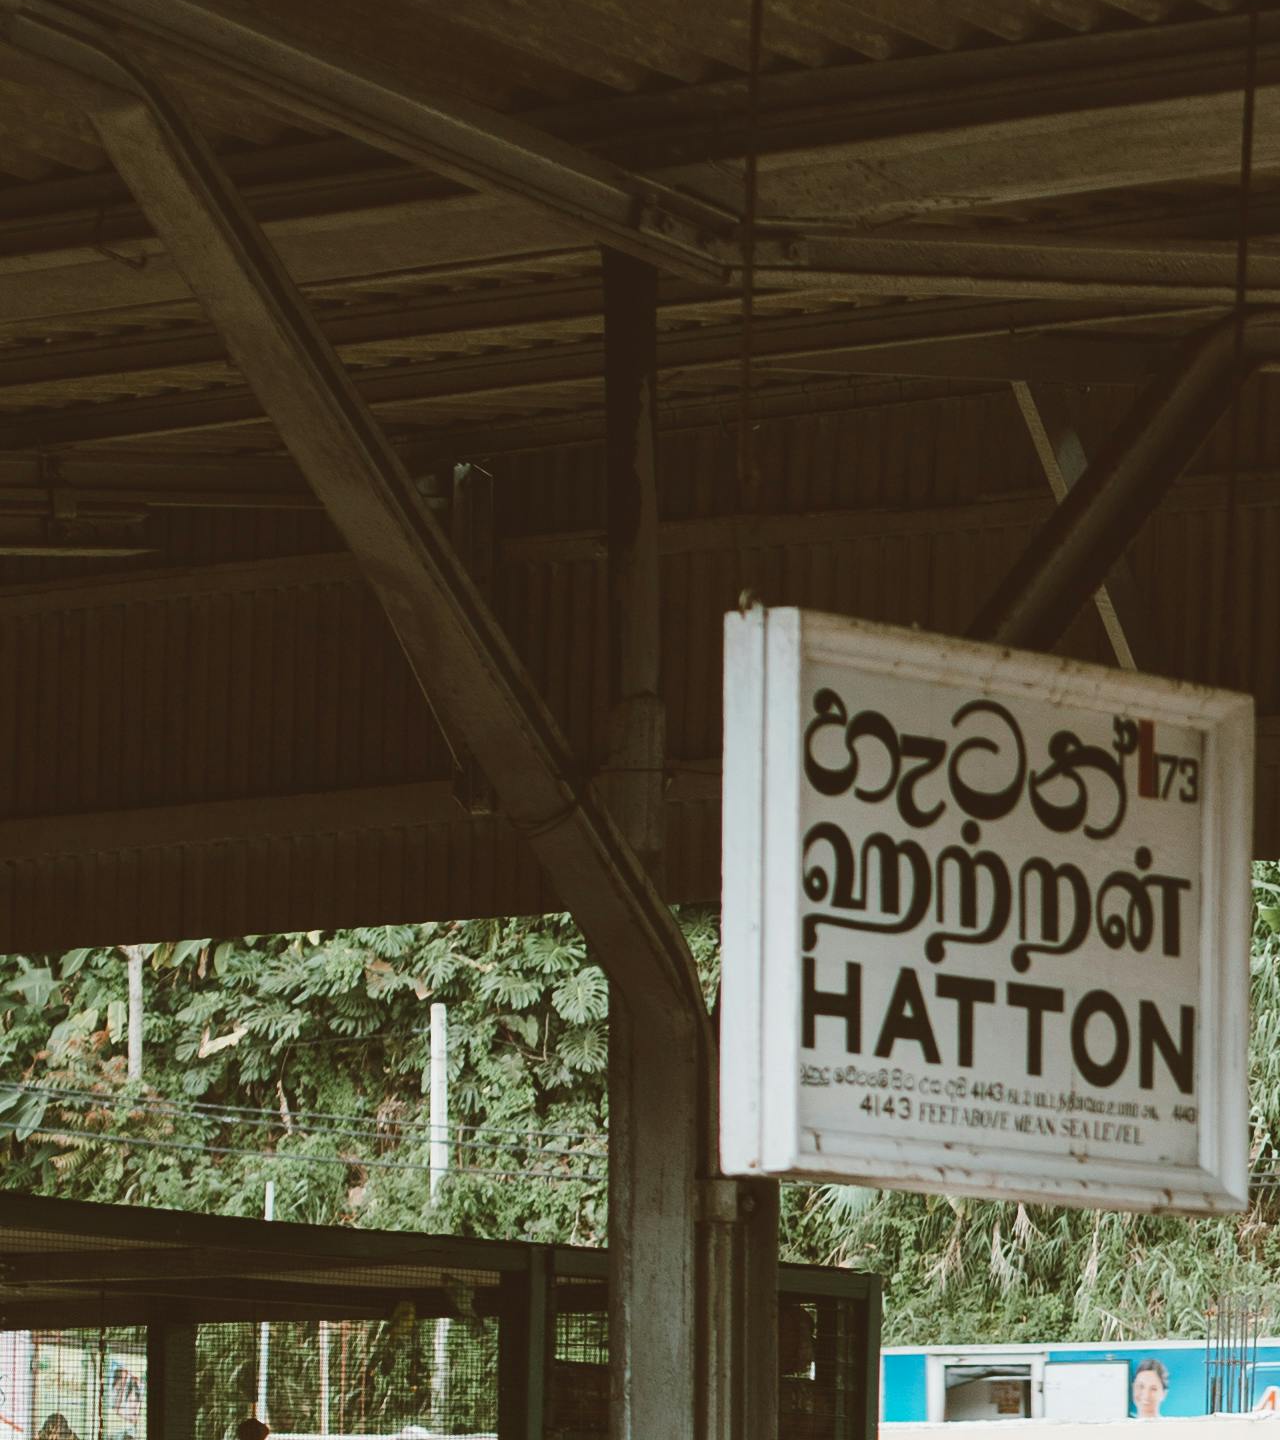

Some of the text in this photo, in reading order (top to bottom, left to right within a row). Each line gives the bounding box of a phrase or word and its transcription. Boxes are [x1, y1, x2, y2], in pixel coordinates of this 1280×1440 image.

[803, 687, 1138, 839] හැටන්
[803, 820, 1191, 974] ஹற்றன்
[801, 956, 1196, 1095] HATTON
[970, 1081, 1004, 1102] 4143
[860, 1094, 1145, 1146] 4143 FEET ABOVE MEAN SEA LEVEL
